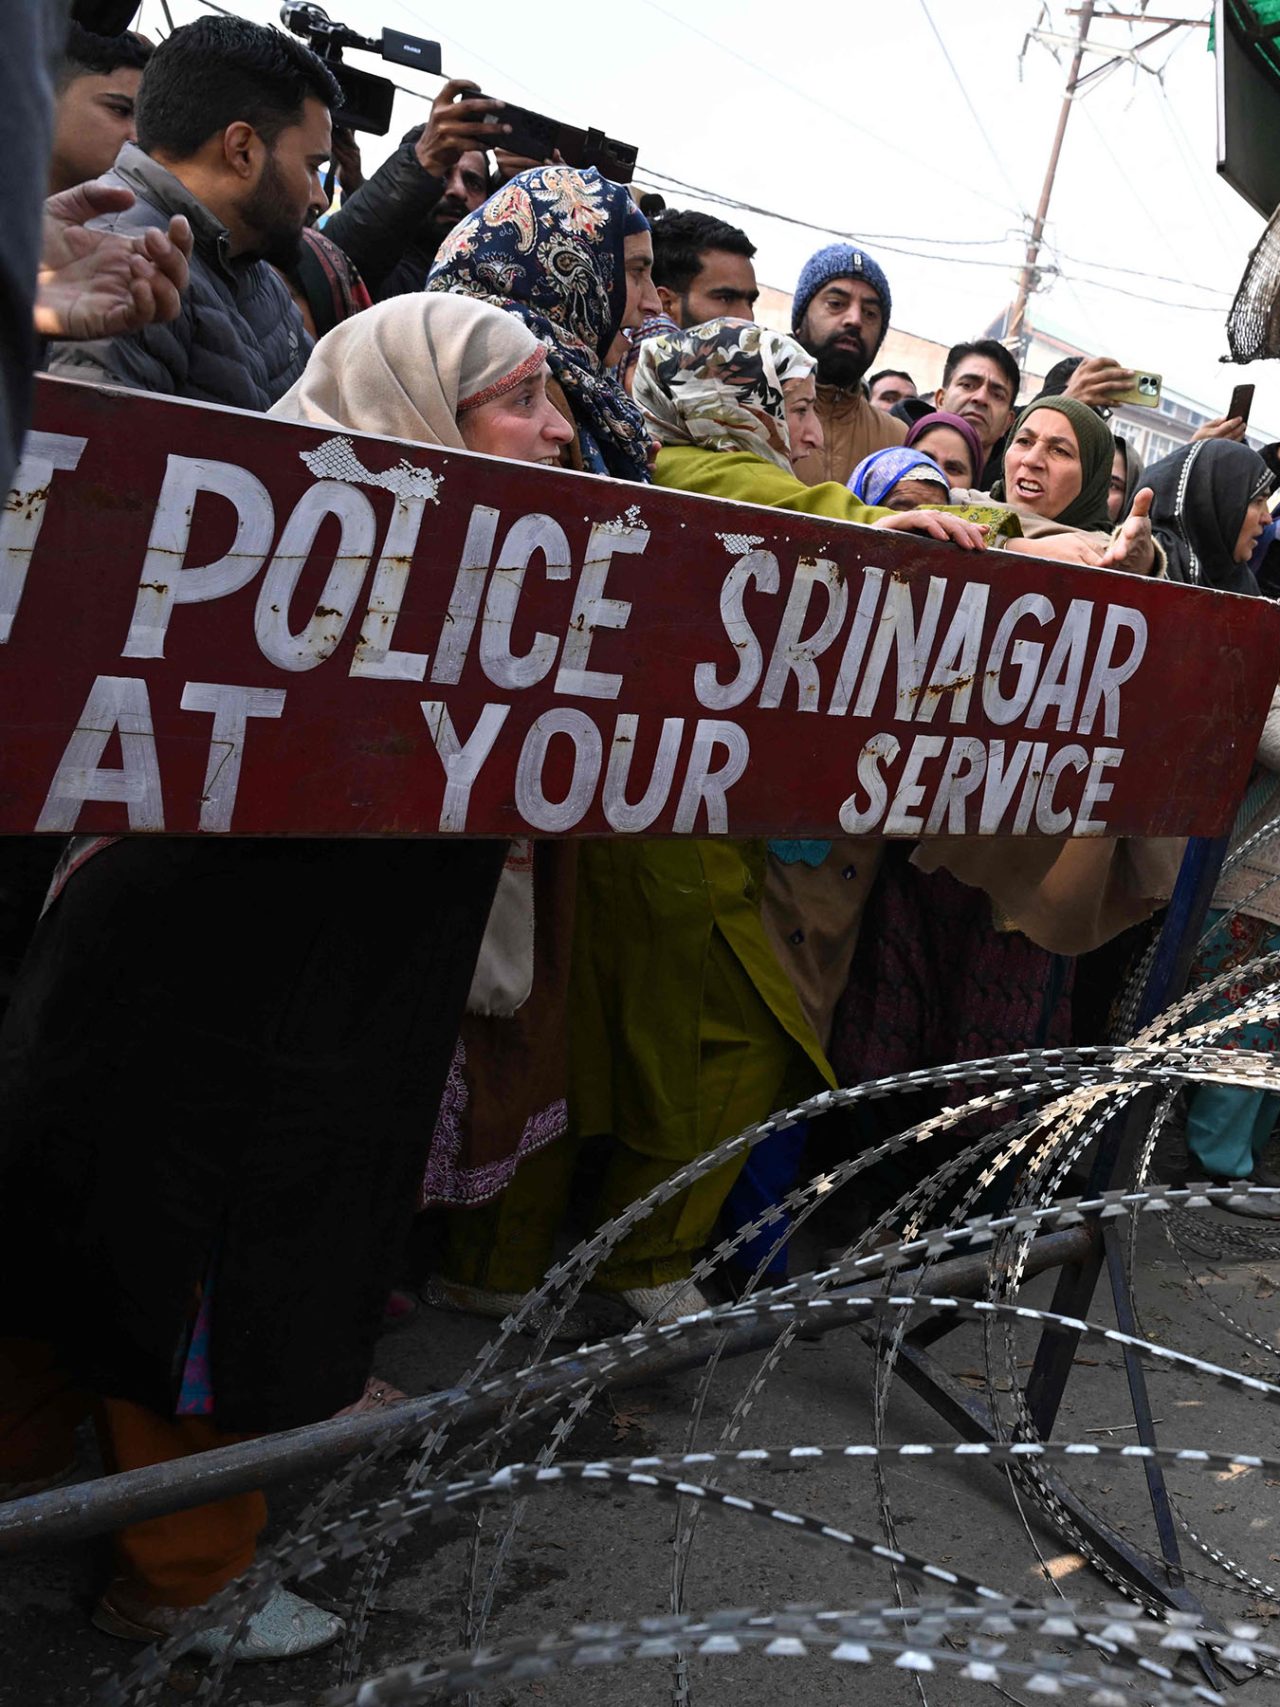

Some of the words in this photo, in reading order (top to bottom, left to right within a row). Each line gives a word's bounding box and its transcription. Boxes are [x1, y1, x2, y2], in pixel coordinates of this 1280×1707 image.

[121, 454, 651, 699] POLICE
[694, 550, 1148, 738] SRINAGAR
[34, 675, 287, 833] AT
[420, 701, 750, 834] YOUR
[838, 732, 1124, 837] SERVICE
